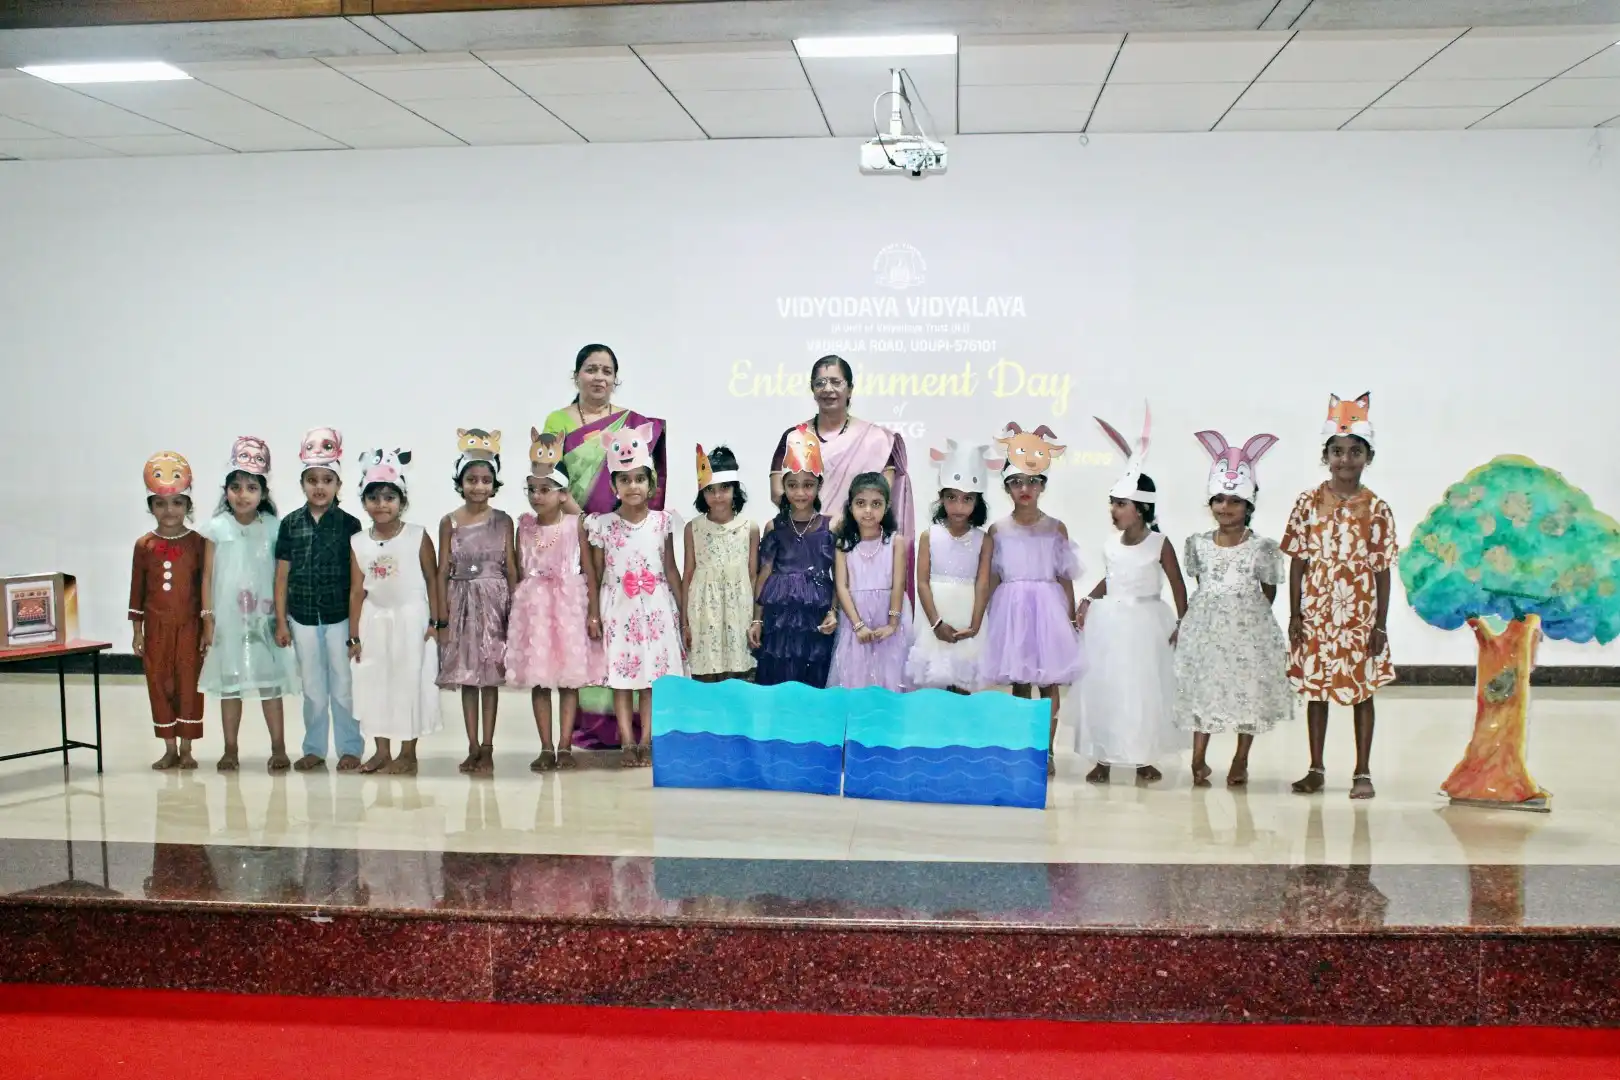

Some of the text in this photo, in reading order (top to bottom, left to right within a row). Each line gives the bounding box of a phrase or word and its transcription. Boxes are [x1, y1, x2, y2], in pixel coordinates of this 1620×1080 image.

[776, 296, 1027, 318] VIDYODAYA VIDYALAYA
[925, 323, 948, 333] Trust
[806, 339, 997, 355] VADIRAJA ROAD, UDUPI-576101
[728, 358, 1072, 418] Enteinment Day
[892, 401, 908, 418] of
